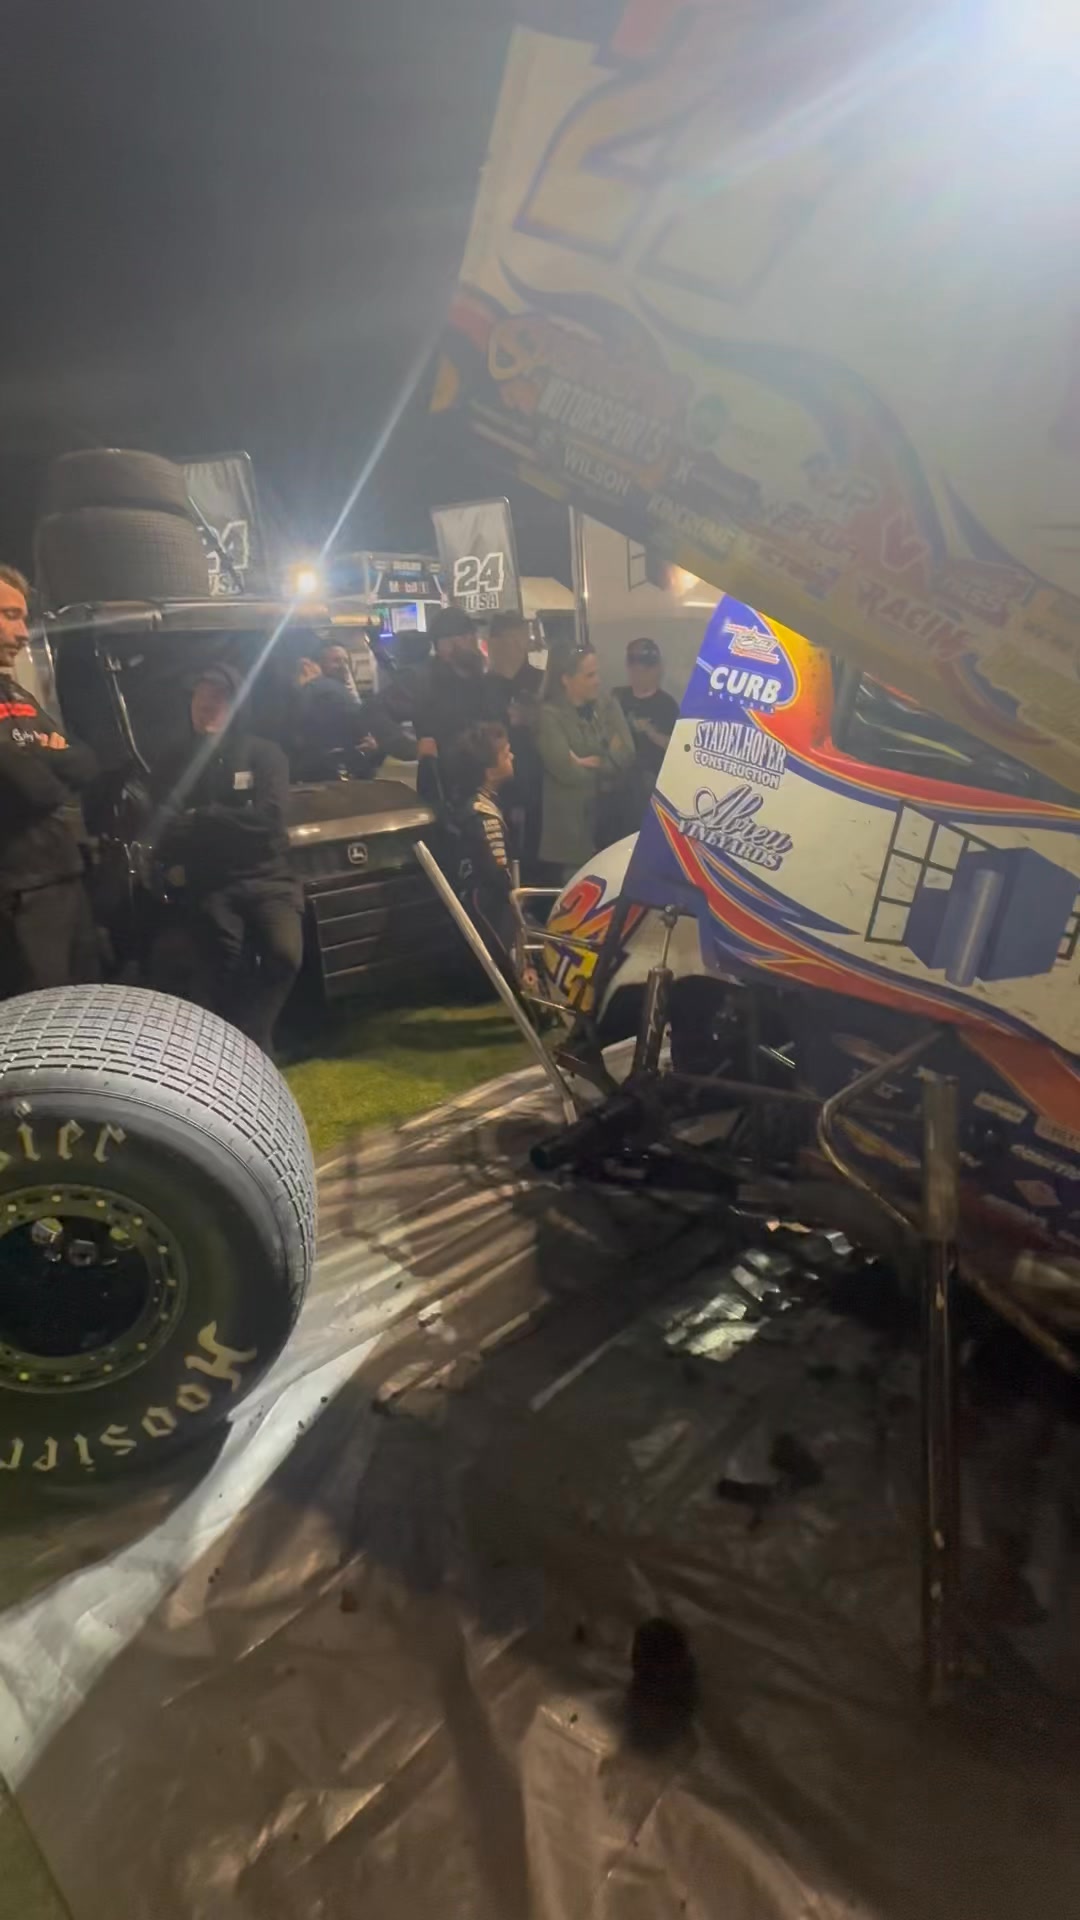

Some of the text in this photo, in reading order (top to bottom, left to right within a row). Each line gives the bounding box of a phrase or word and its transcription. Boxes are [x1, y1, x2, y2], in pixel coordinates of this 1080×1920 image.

[563, 446, 631, 497] WILSON
[453, 552, 504, 597] 24
[465, 592, 500, 612] USA
[709, 666, 782, 704] CURB
[693, 720, 787, 775] STADELHOFER
[693, 749, 781, 791] CONSTRUCTION
[679, 784, 794, 854] Abreu
[678, 819, 784, 872] VINEYARDS
